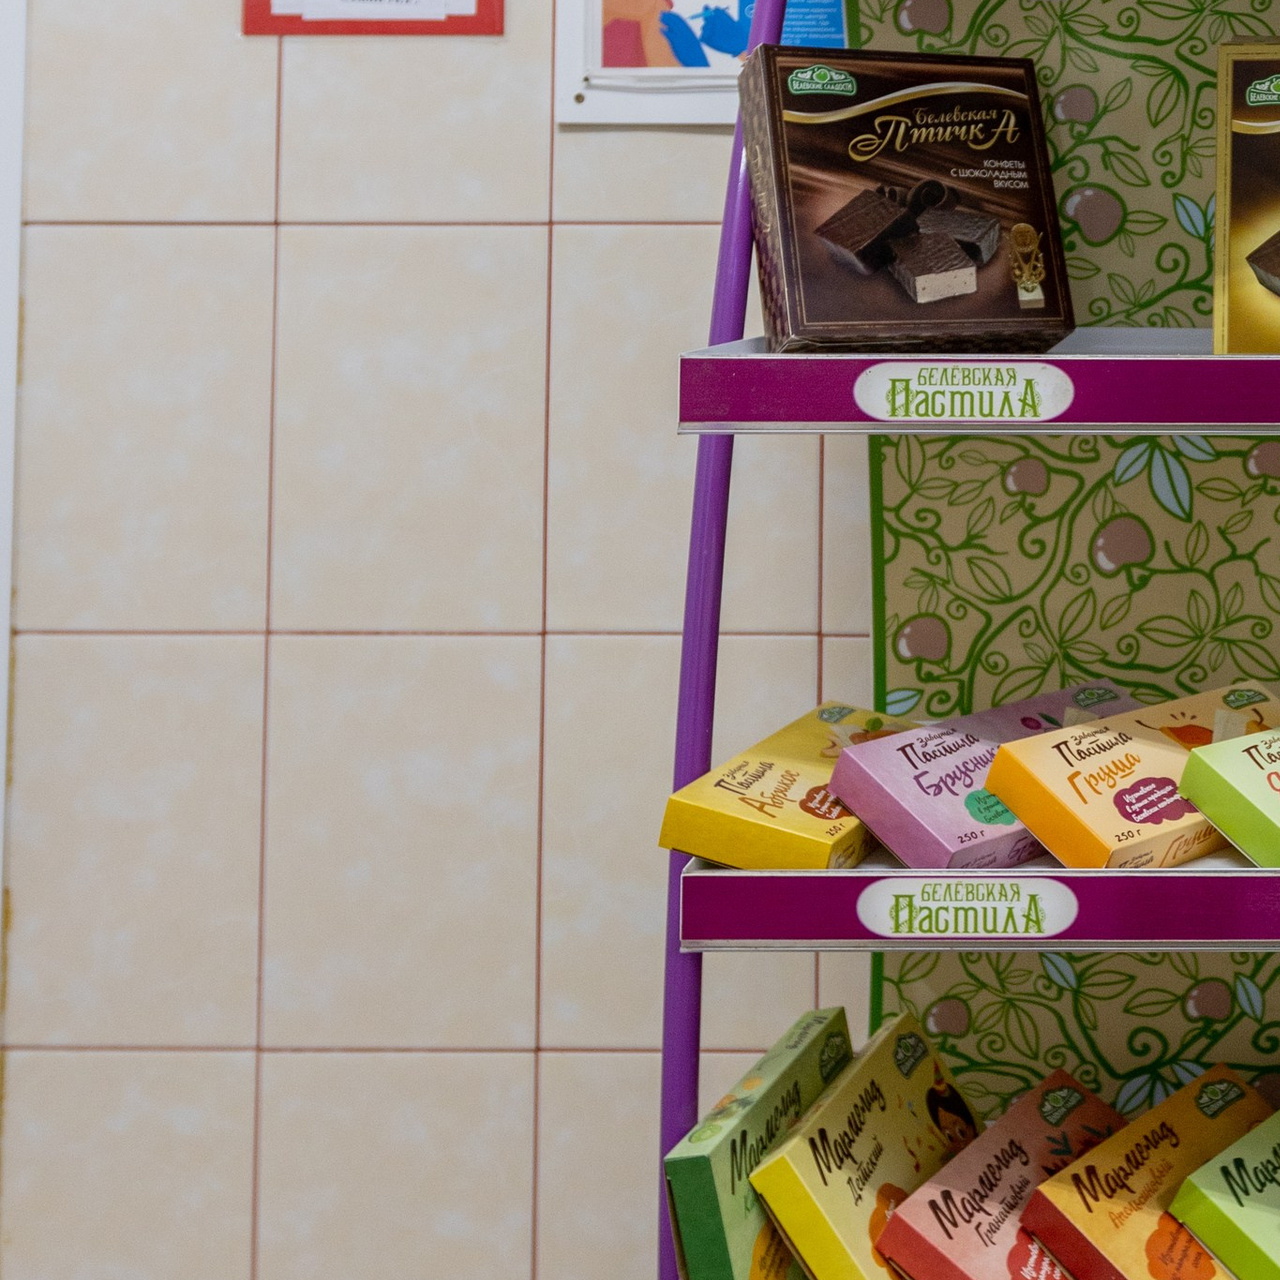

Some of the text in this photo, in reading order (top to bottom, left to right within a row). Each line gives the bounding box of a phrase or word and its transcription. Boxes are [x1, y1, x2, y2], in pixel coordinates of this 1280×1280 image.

[911, 106, 999, 125] Белевская
[959, 168, 1028, 180] ШОКОЛАДНЫМ
[983, 159, 1027, 170] КОНФЕТЫ
[993, 179, 1030, 189] ВКУСОМ
[917, 364, 1018, 388] БЕЛЁВСКАЯ
[896, 733, 980, 770] Пастила
[1052, 732, 1133, 768] Пастила
[913, 745, 999, 797] Брусник
[1067, 752, 1141, 805] Груша
[738, 769, 800, 819] Абрикос
[957, 832, 979, 844] 250
[1115, 830, 1135, 843] 250
[920, 880, 1021, 902] БЕЛЁВСКАЯ
[809, 1078, 887, 1186] Мармелад
[845, 1134, 884, 1206] Детский
[1071, 1121, 1181, 1214] Мармелад
[928, 1138, 1031, 1240] Мармелад
[1107, 1158, 1177, 1230] Апельсиновый
[974, 1173, 1032, 1248] Гранатовый
